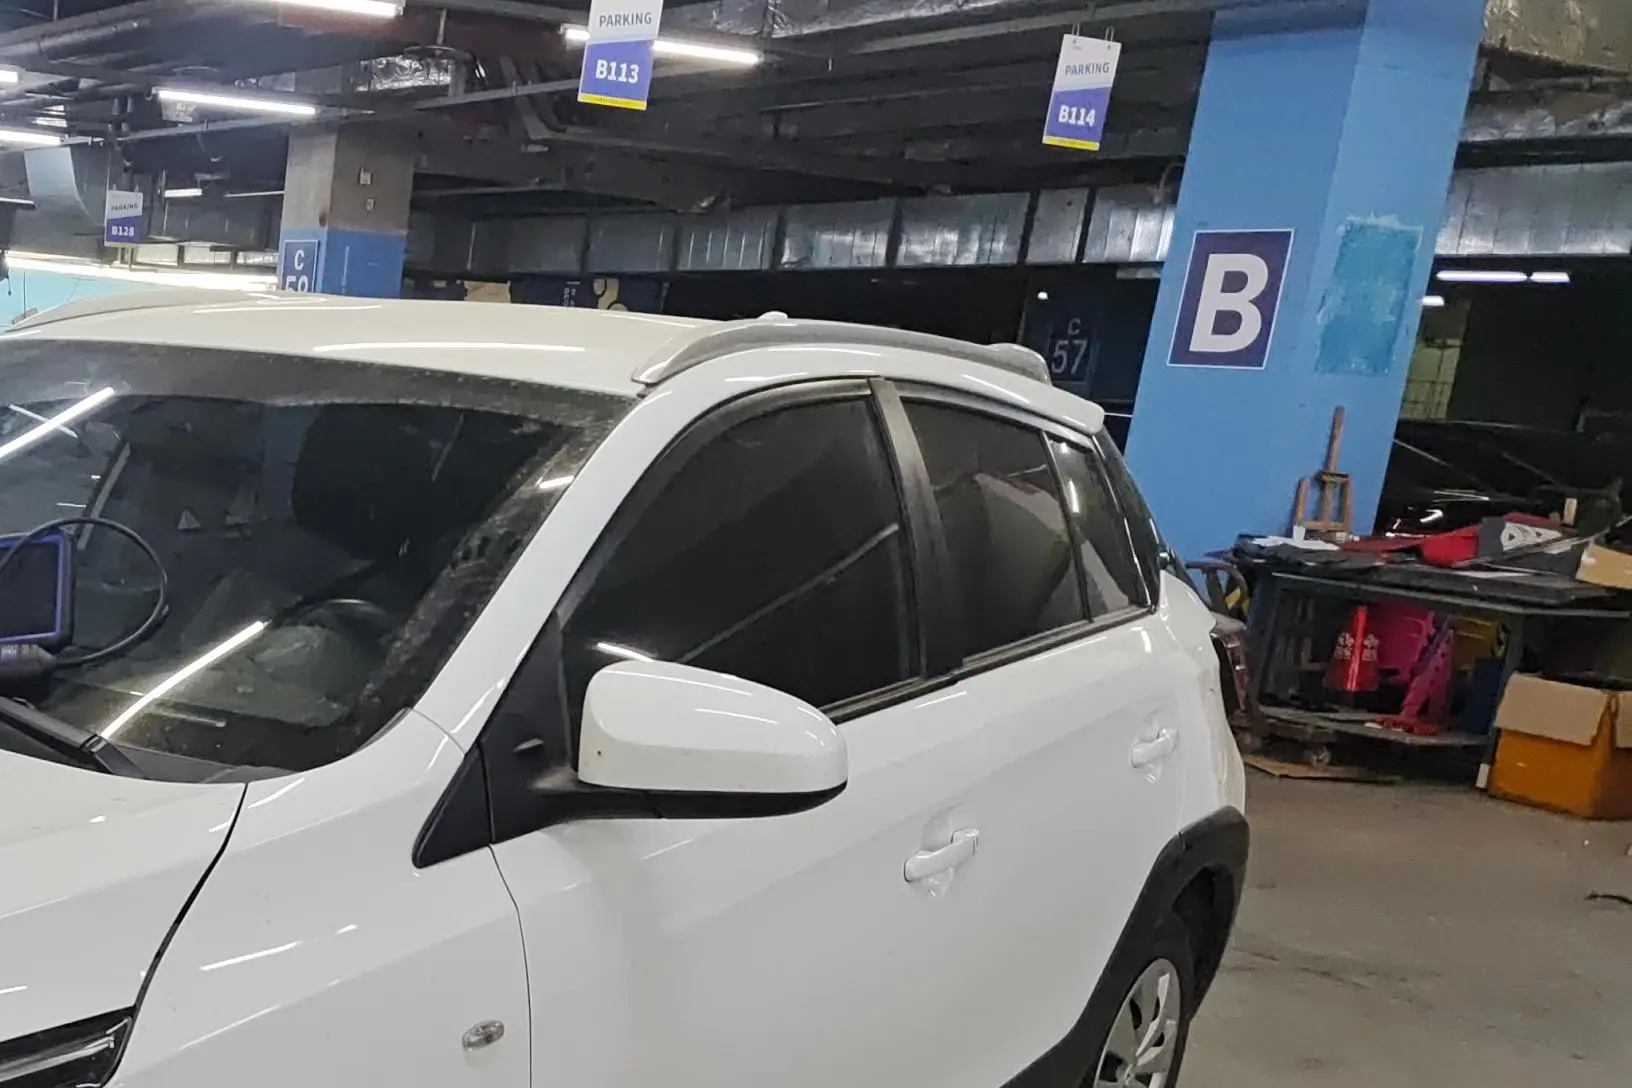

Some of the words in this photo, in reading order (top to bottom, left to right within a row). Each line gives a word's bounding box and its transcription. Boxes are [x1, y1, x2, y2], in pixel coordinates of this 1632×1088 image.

[599, 12, 652, 28] PARKING
[596, 59, 639, 84] B113
[1065, 62, 1110, 76] PARKING
[1058, 105, 1096, 128] B114
[294, 249, 305, 270] C
[1189, 253, 1268, 352] B
[1068, 318, 1081, 335] C
[1051, 339, 1088, 374] 57
